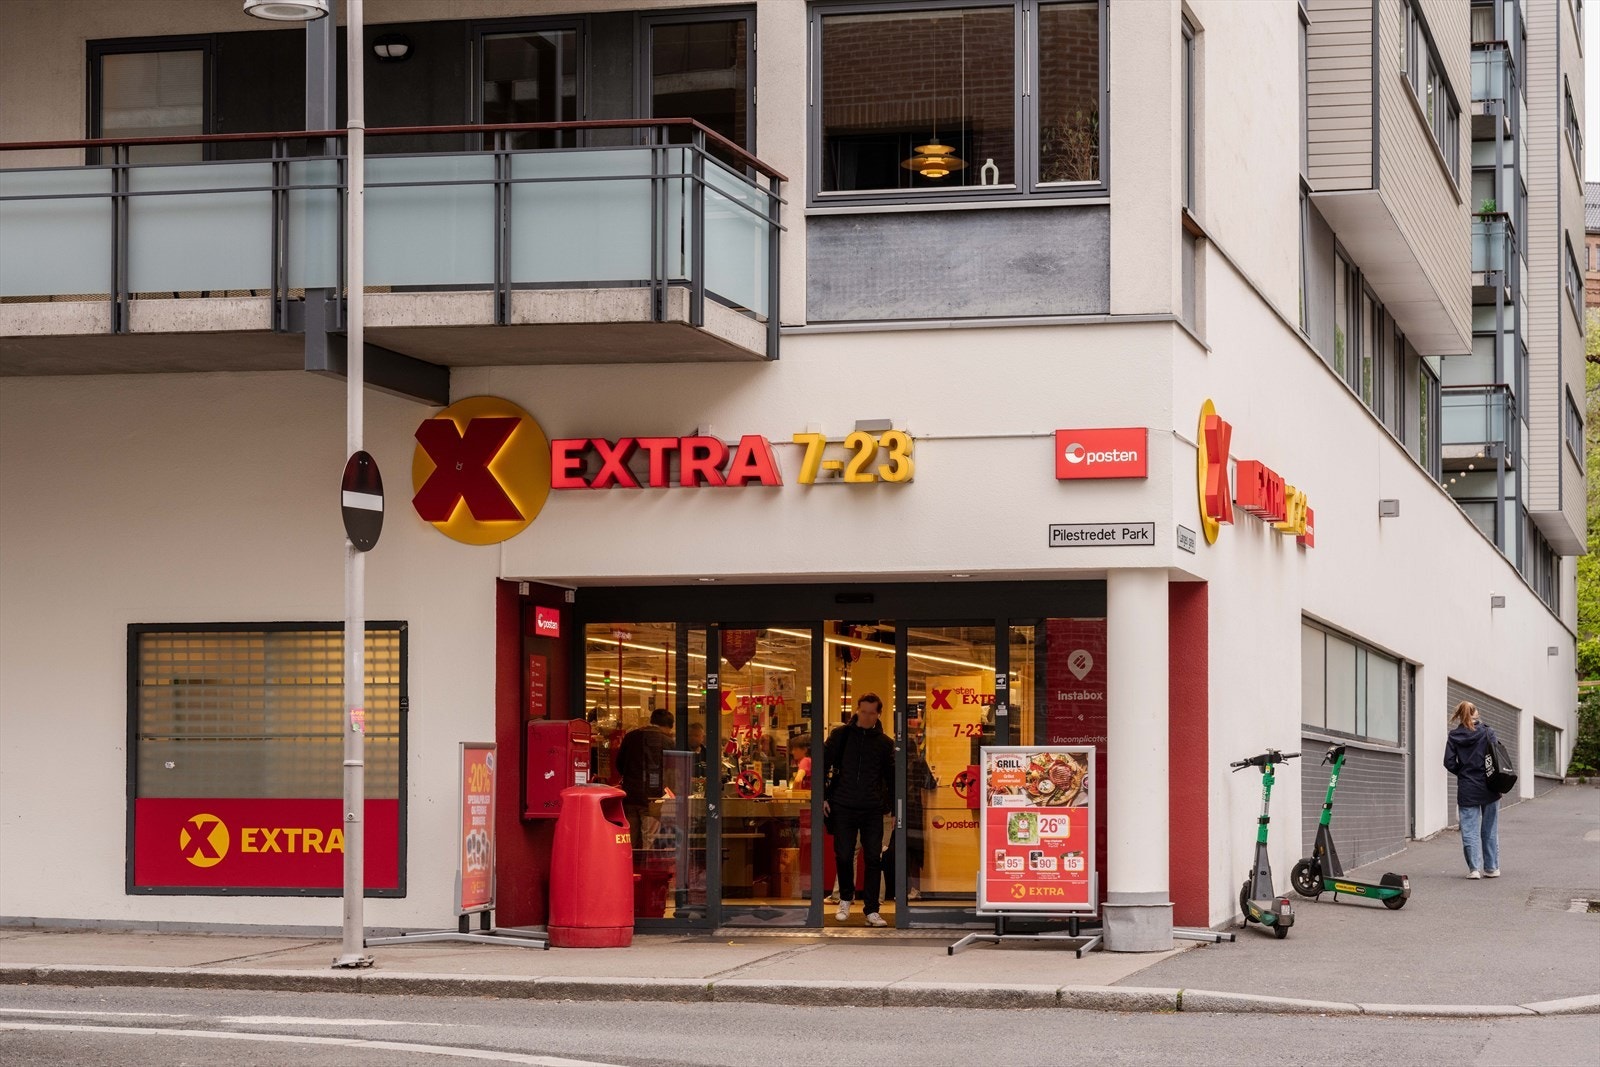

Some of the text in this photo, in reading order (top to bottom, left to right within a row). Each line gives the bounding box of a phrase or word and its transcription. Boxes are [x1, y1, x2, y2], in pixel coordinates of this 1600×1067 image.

[1087, 449, 1138, 465] posten
[412, 417, 915, 522] X EXTRA 7-23
[1052, 527, 1148, 541] Pilestredet Park
[741, 696, 785, 705] EXTRA
[962, 694, 997, 705] EXTR
[1057, 690, 1103, 701] instabox
[953, 723, 983, 738] 7-23
[997, 759, 1021, 768] GRILL
[468, 763, 491, 793] -20%
[946, 820, 980, 831] posten
[1040, 818, 1058, 833] 26
[241, 827, 345, 854] EXTRA
[1007, 858, 1018, 868] 95
[1040, 858, 1051, 868] 90
[1067, 859, 1077, 868] 15
[1029, 887, 1065, 896] EXTRA
